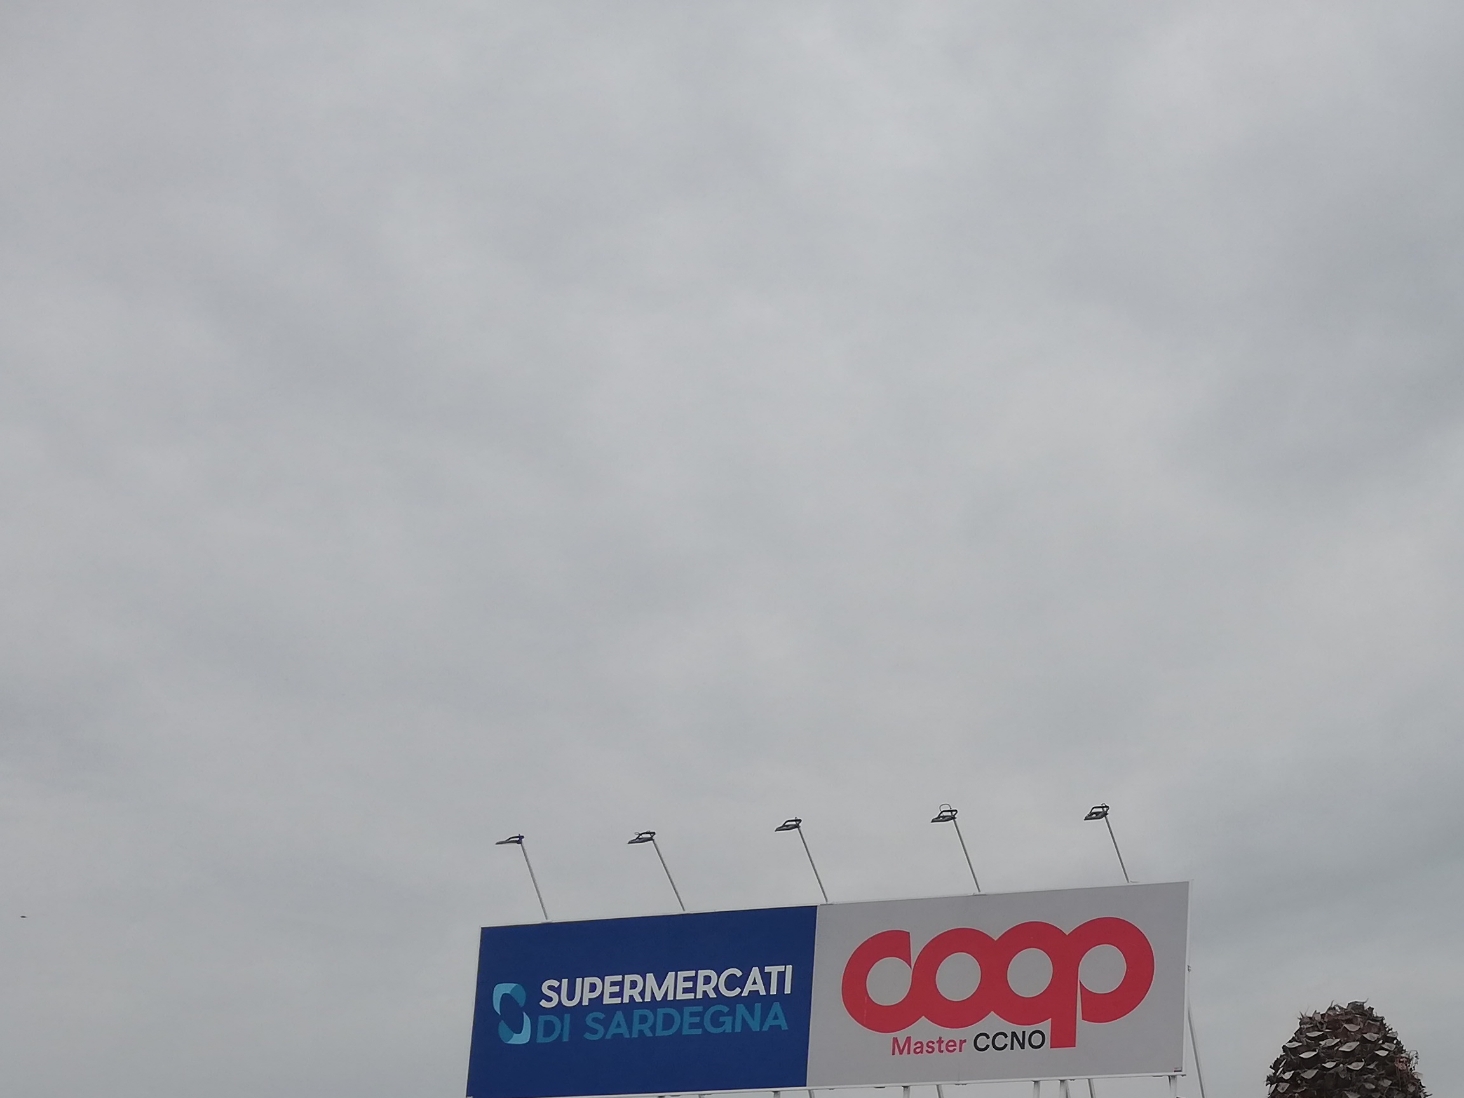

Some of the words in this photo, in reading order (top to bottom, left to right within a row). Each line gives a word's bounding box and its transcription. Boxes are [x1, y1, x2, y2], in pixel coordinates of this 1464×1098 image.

[539, 964, 793, 1010] SUPERMERCATI
[841, 916, 1155, 1048] coop
[536, 1012, 571, 1043] DI
[584, 1003, 788, 1040] SARDEGNA
[891, 1033, 966, 1056] Master
[973, 1029, 1047, 1052] CCNO
